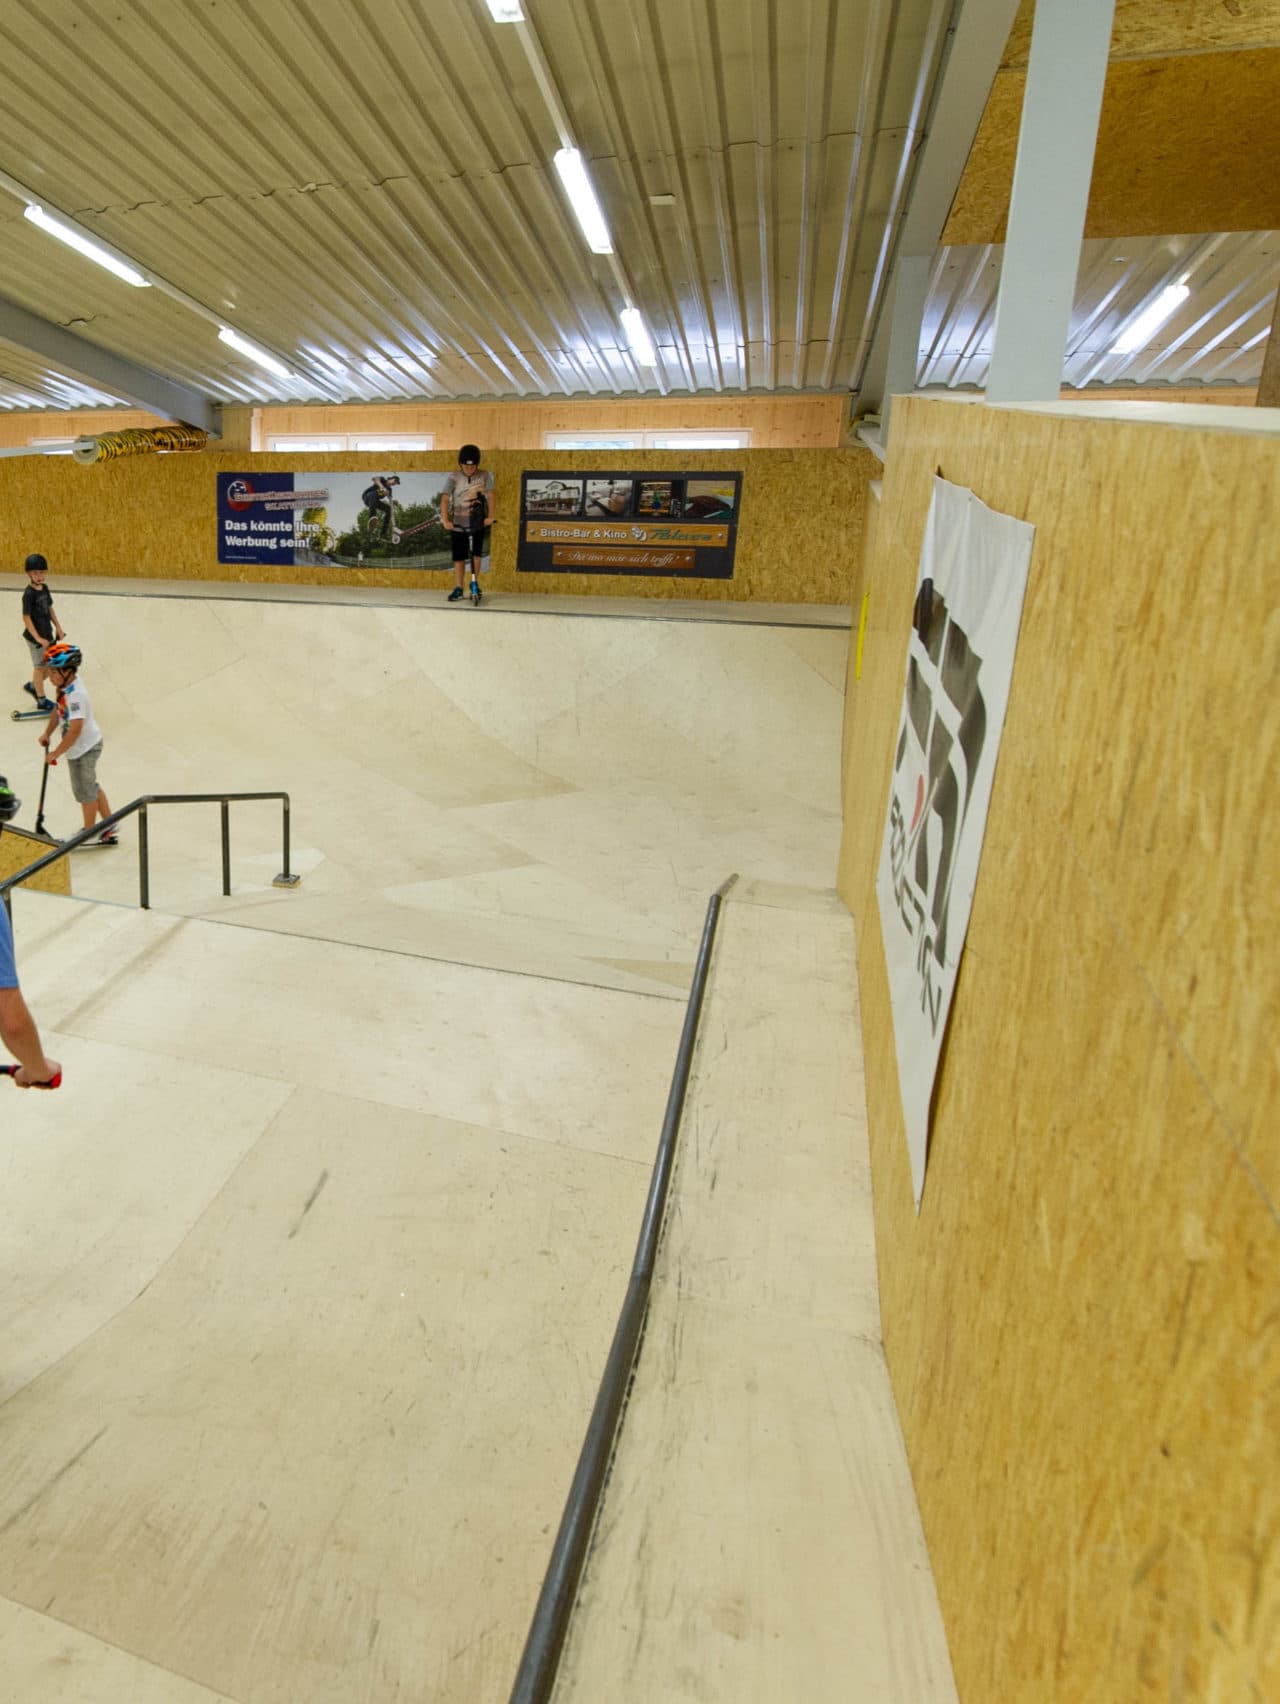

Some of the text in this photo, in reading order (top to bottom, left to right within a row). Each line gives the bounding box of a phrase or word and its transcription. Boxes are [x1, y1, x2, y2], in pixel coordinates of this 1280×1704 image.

[225, 519, 320, 533] Das könnte Ihre
[540, 527, 591, 539] Bistro-Bar
[593, 529, 602, 539] &
[603, 529, 628, 540] Kino
[225, 535, 310, 549] Werbung sein!
